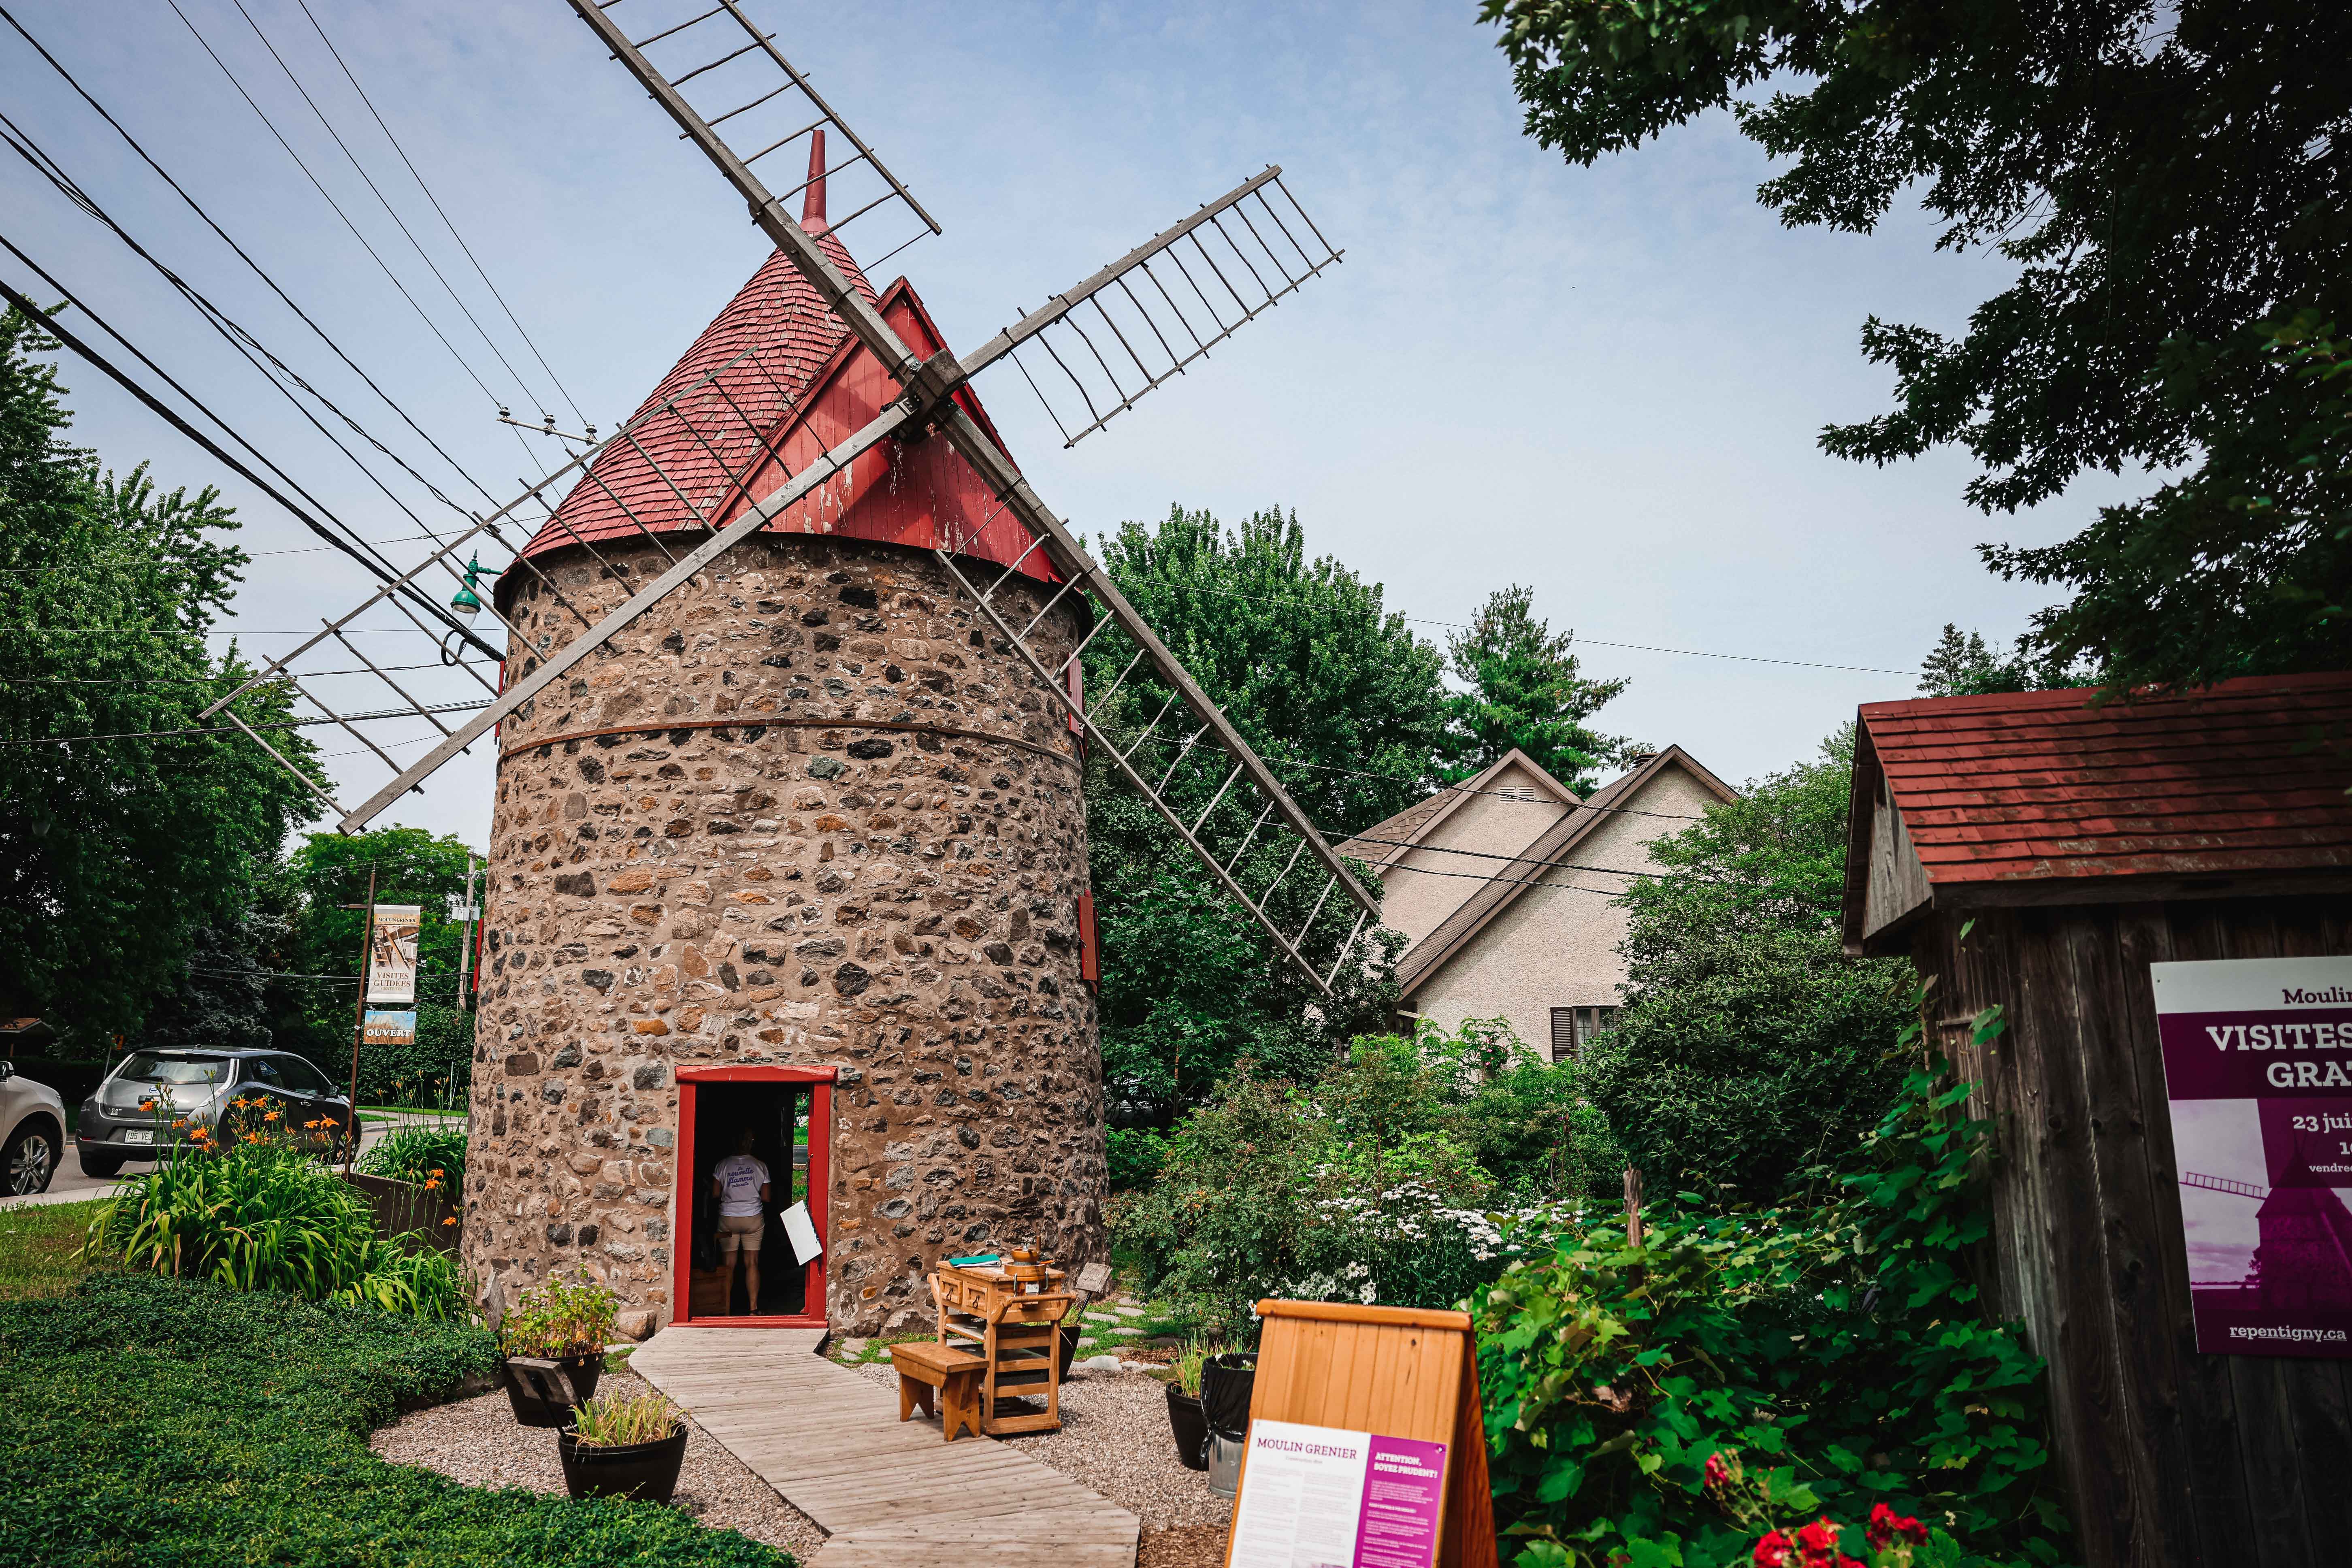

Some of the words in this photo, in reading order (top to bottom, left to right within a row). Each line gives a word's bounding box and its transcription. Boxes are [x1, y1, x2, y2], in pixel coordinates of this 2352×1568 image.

[373, 978, 411, 987] GUIDÉES
[366, 1029, 411, 1037] OUVERT
[2267, 1061, 2352, 1088] GRA
[2292, 1116, 2319, 1132] 23
[2322, 1112, 2352, 1133] jui
[2309, 1163, 2352, 1172] vendre
[2229, 1325, 2347, 1342] repentigny.ca
[1257, 1437, 1303, 1452] MOULIN
[1305, 1444, 1357, 1459] GRENIER
[1375, 1452, 1422, 1466] ATTENTION,
